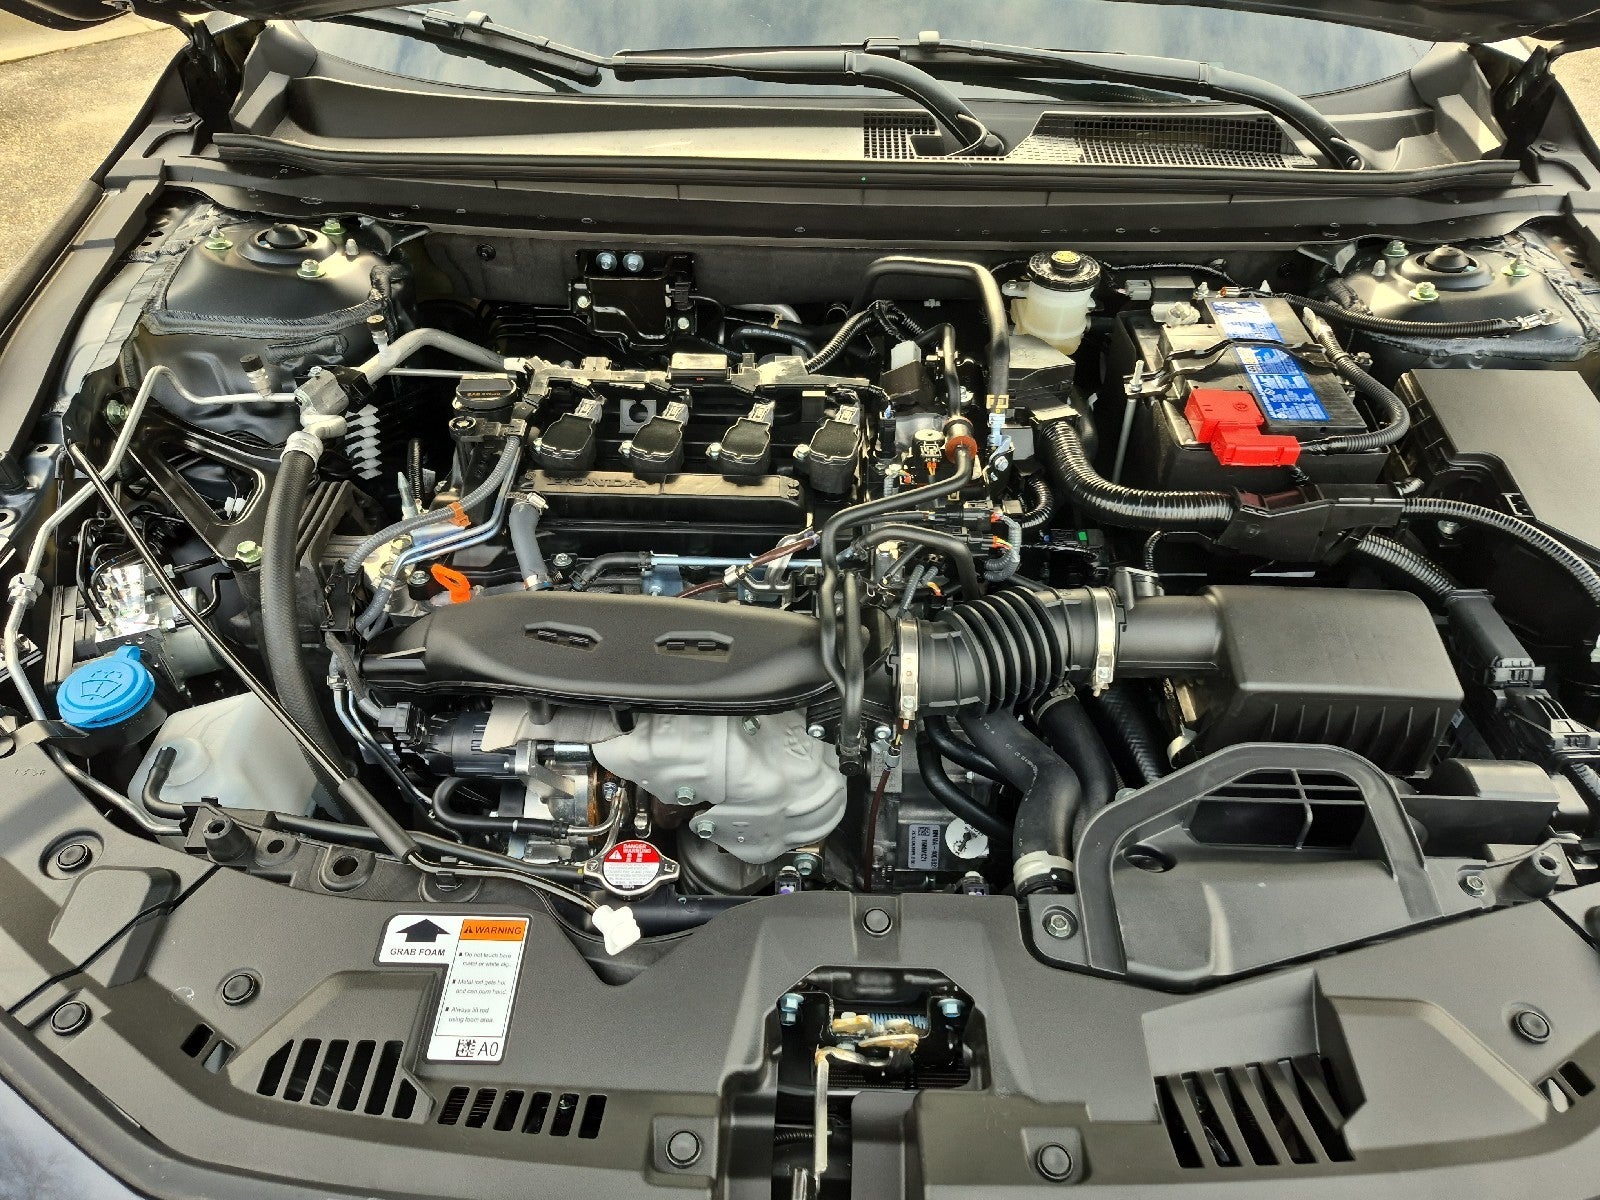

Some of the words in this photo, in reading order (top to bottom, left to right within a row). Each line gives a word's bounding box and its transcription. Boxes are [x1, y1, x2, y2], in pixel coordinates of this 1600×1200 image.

[546, 477, 647, 488] HONDA
[475, 926, 522, 935] WARNING
[390, 948, 417, 956] GRAB
[418, 948, 446, 956] FOAM
[477, 1041, 499, 1057] A0
